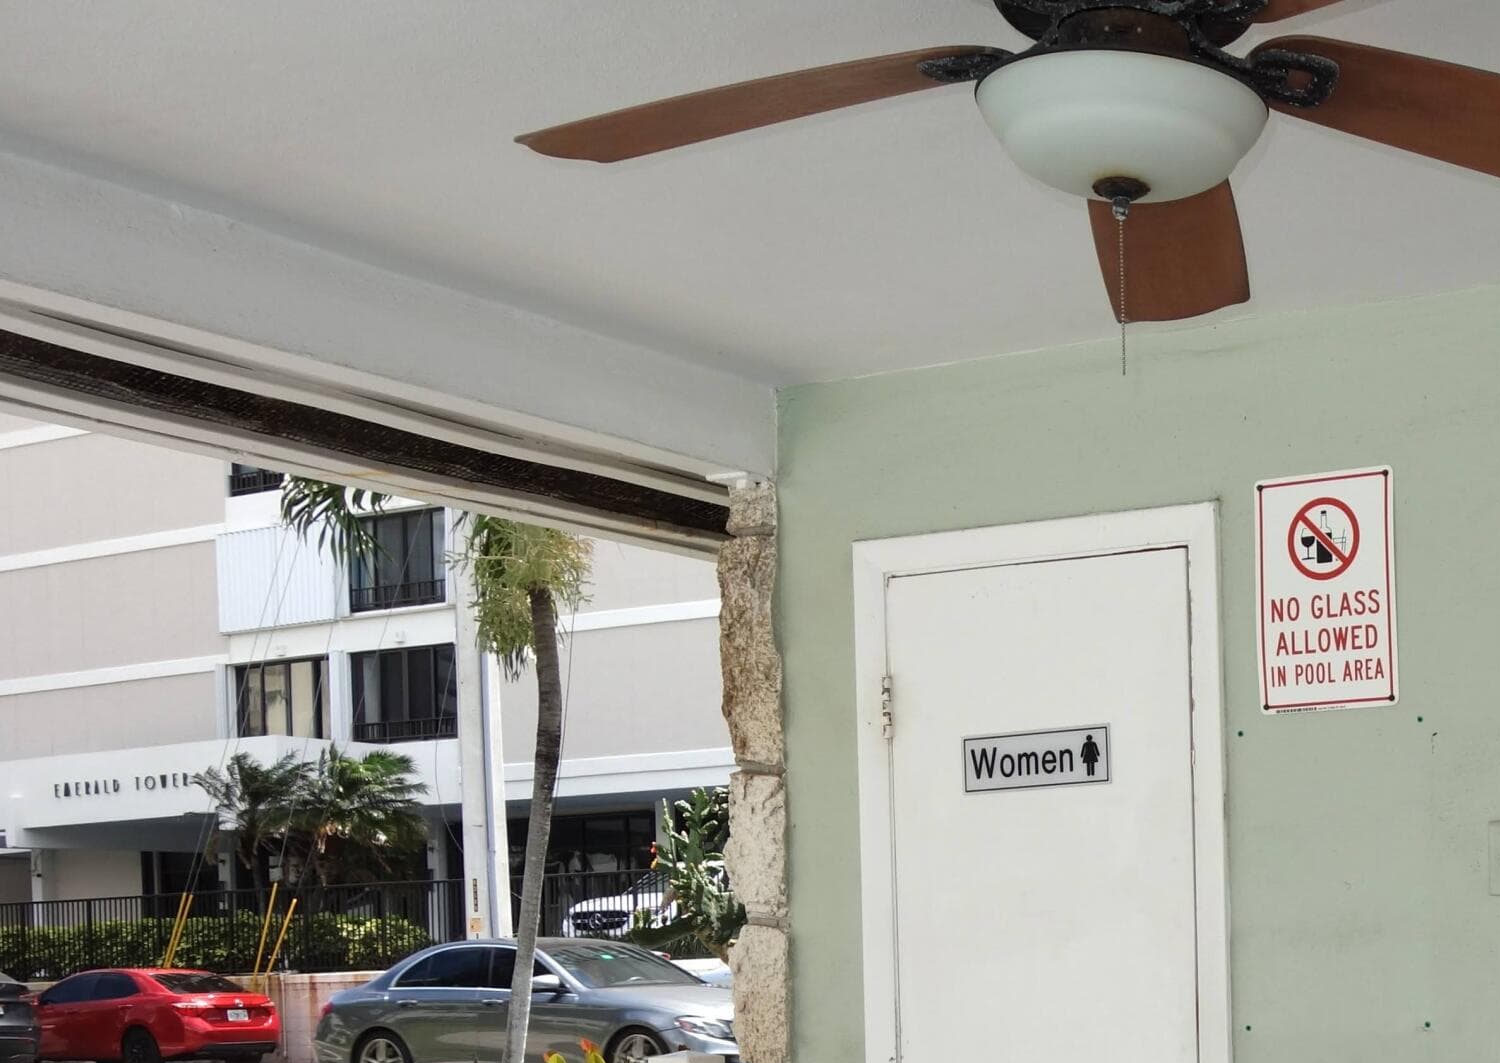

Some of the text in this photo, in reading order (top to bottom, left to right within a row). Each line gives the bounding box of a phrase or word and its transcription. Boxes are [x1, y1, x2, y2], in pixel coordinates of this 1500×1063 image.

[1271, 589, 1380, 623] NO GLASS
[1276, 624, 1378, 656] ALLOWED
[1271, 658, 1385, 687] IN POOL AREA
[970, 747, 1073, 779] Women
[54, 773, 198, 798] EMERALD TOWER
